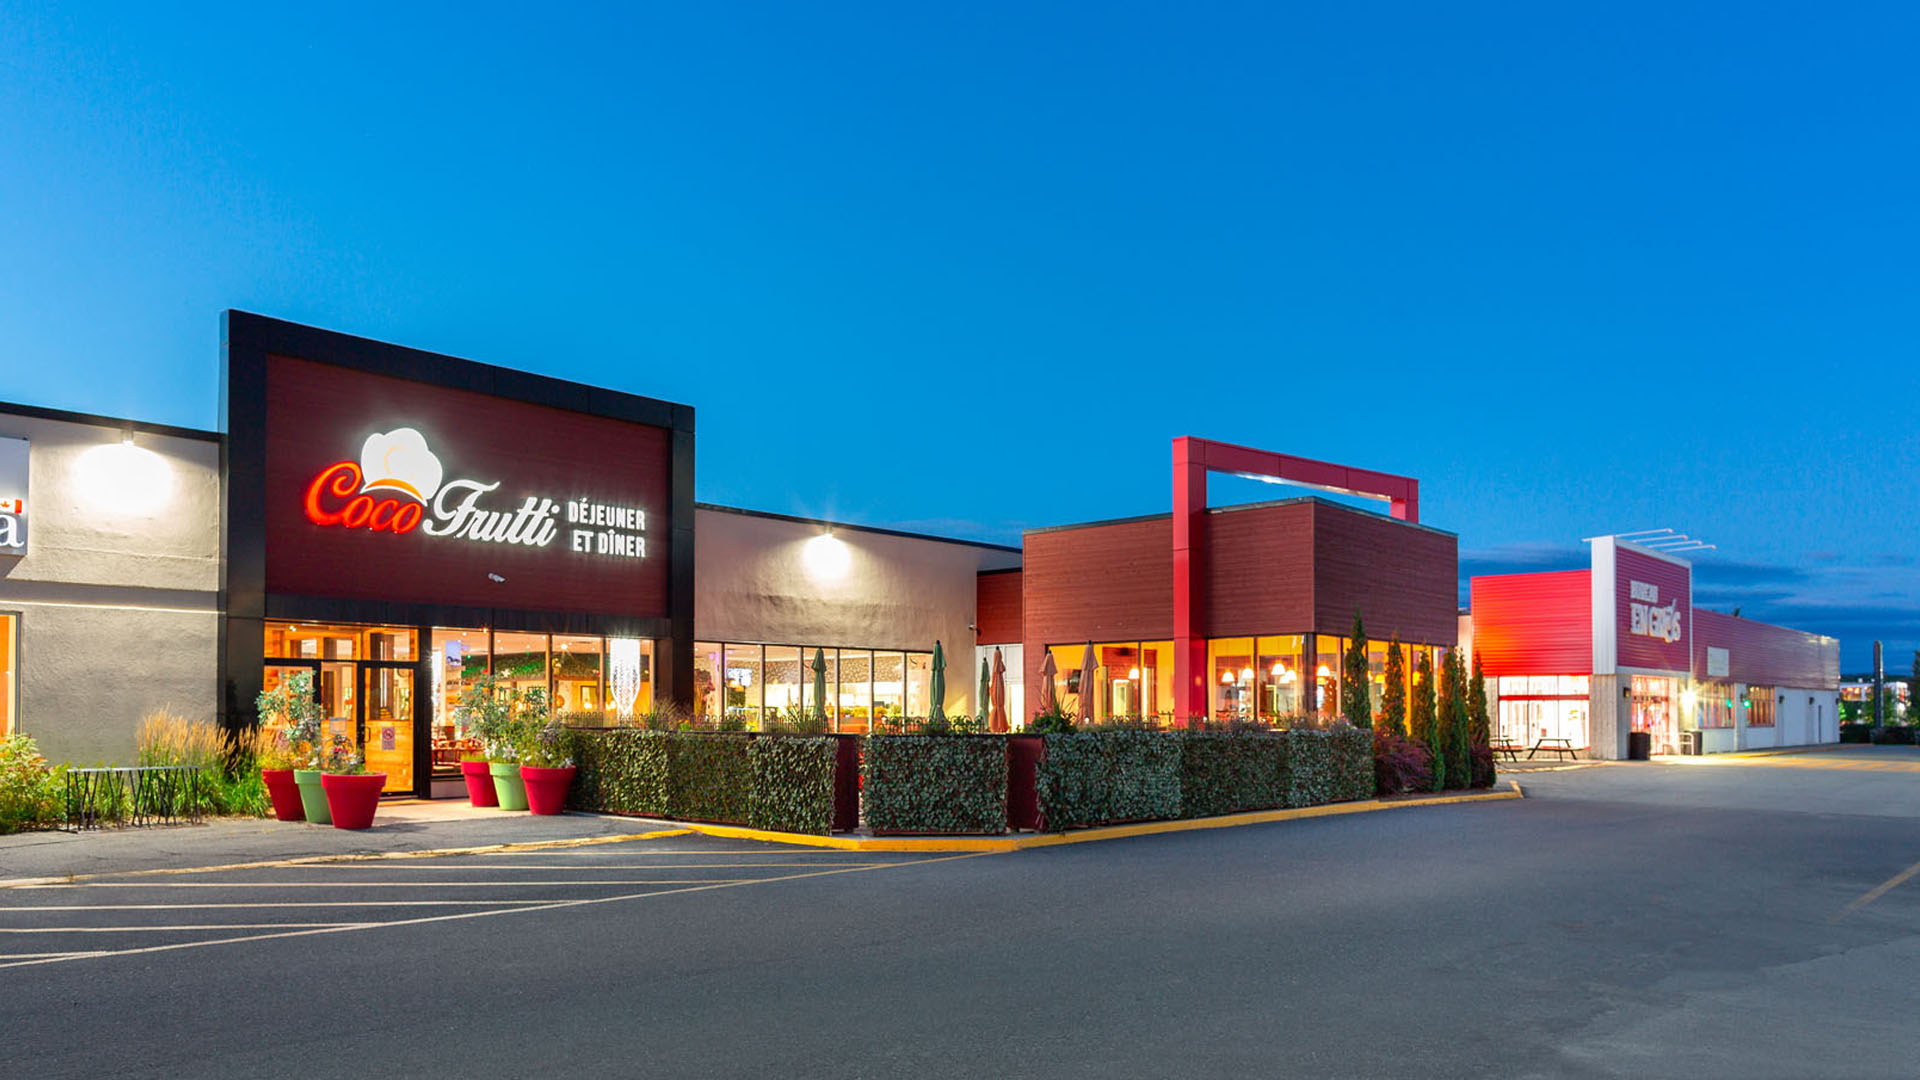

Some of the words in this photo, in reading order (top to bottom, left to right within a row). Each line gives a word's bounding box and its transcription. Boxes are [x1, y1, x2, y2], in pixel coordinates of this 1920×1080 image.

[305, 461, 423, 535] Coco
[422, 480, 560, 547] Frutti
[568, 498, 646, 531] DÉJEUNER
[573, 531, 598, 552] ET
[599, 531, 646, 558] DÎNER
